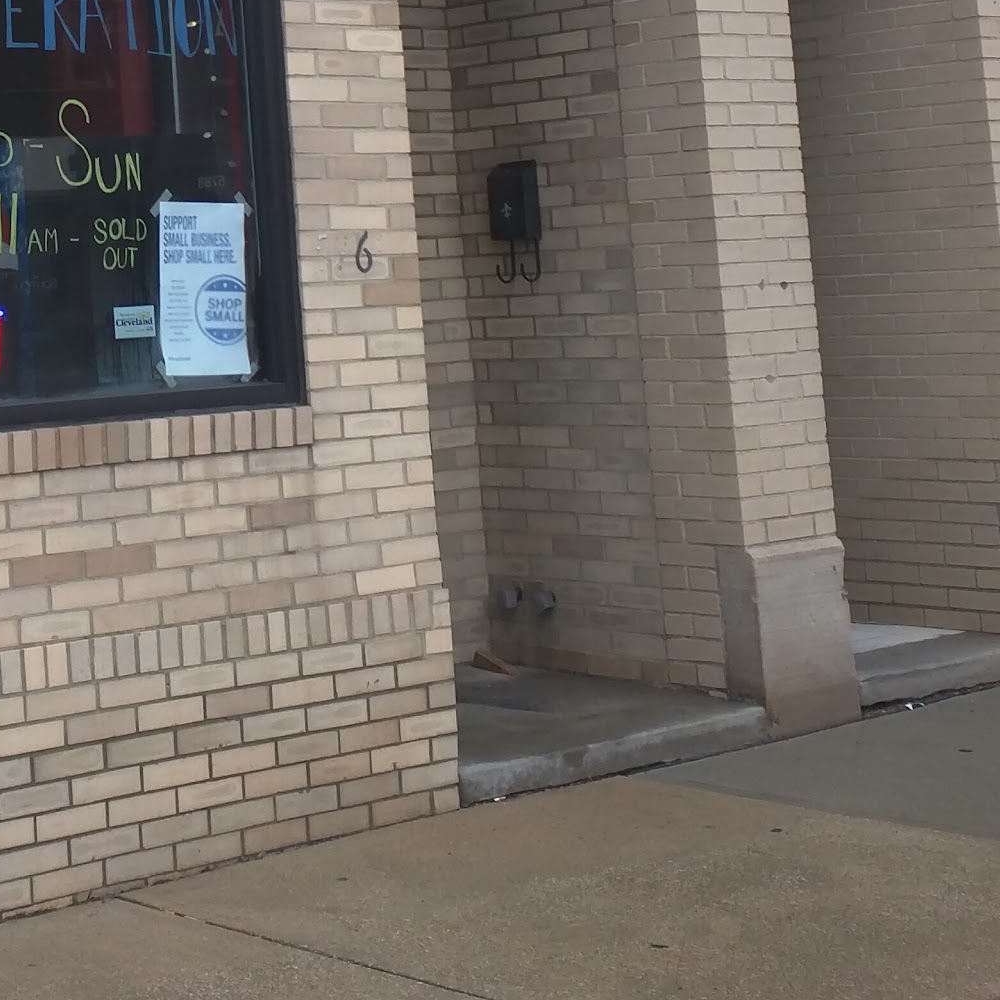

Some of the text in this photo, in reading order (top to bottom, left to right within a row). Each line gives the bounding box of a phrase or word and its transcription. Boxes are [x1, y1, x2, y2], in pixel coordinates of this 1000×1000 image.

[93, 217, 147, 244] SOLD
[163, 215, 197, 231] SUPPORT
[163, 232, 232, 247] SMALL BUSINESS.
[103, 246, 138, 270] OUT
[163, 249, 237, 264] SHOP SMALL HERE.
[355, 230, 373, 274] 6
[208, 298, 242, 311] SHOP
[116, 317, 153, 327] Cleveland
[204, 310, 244, 323] SMALL
